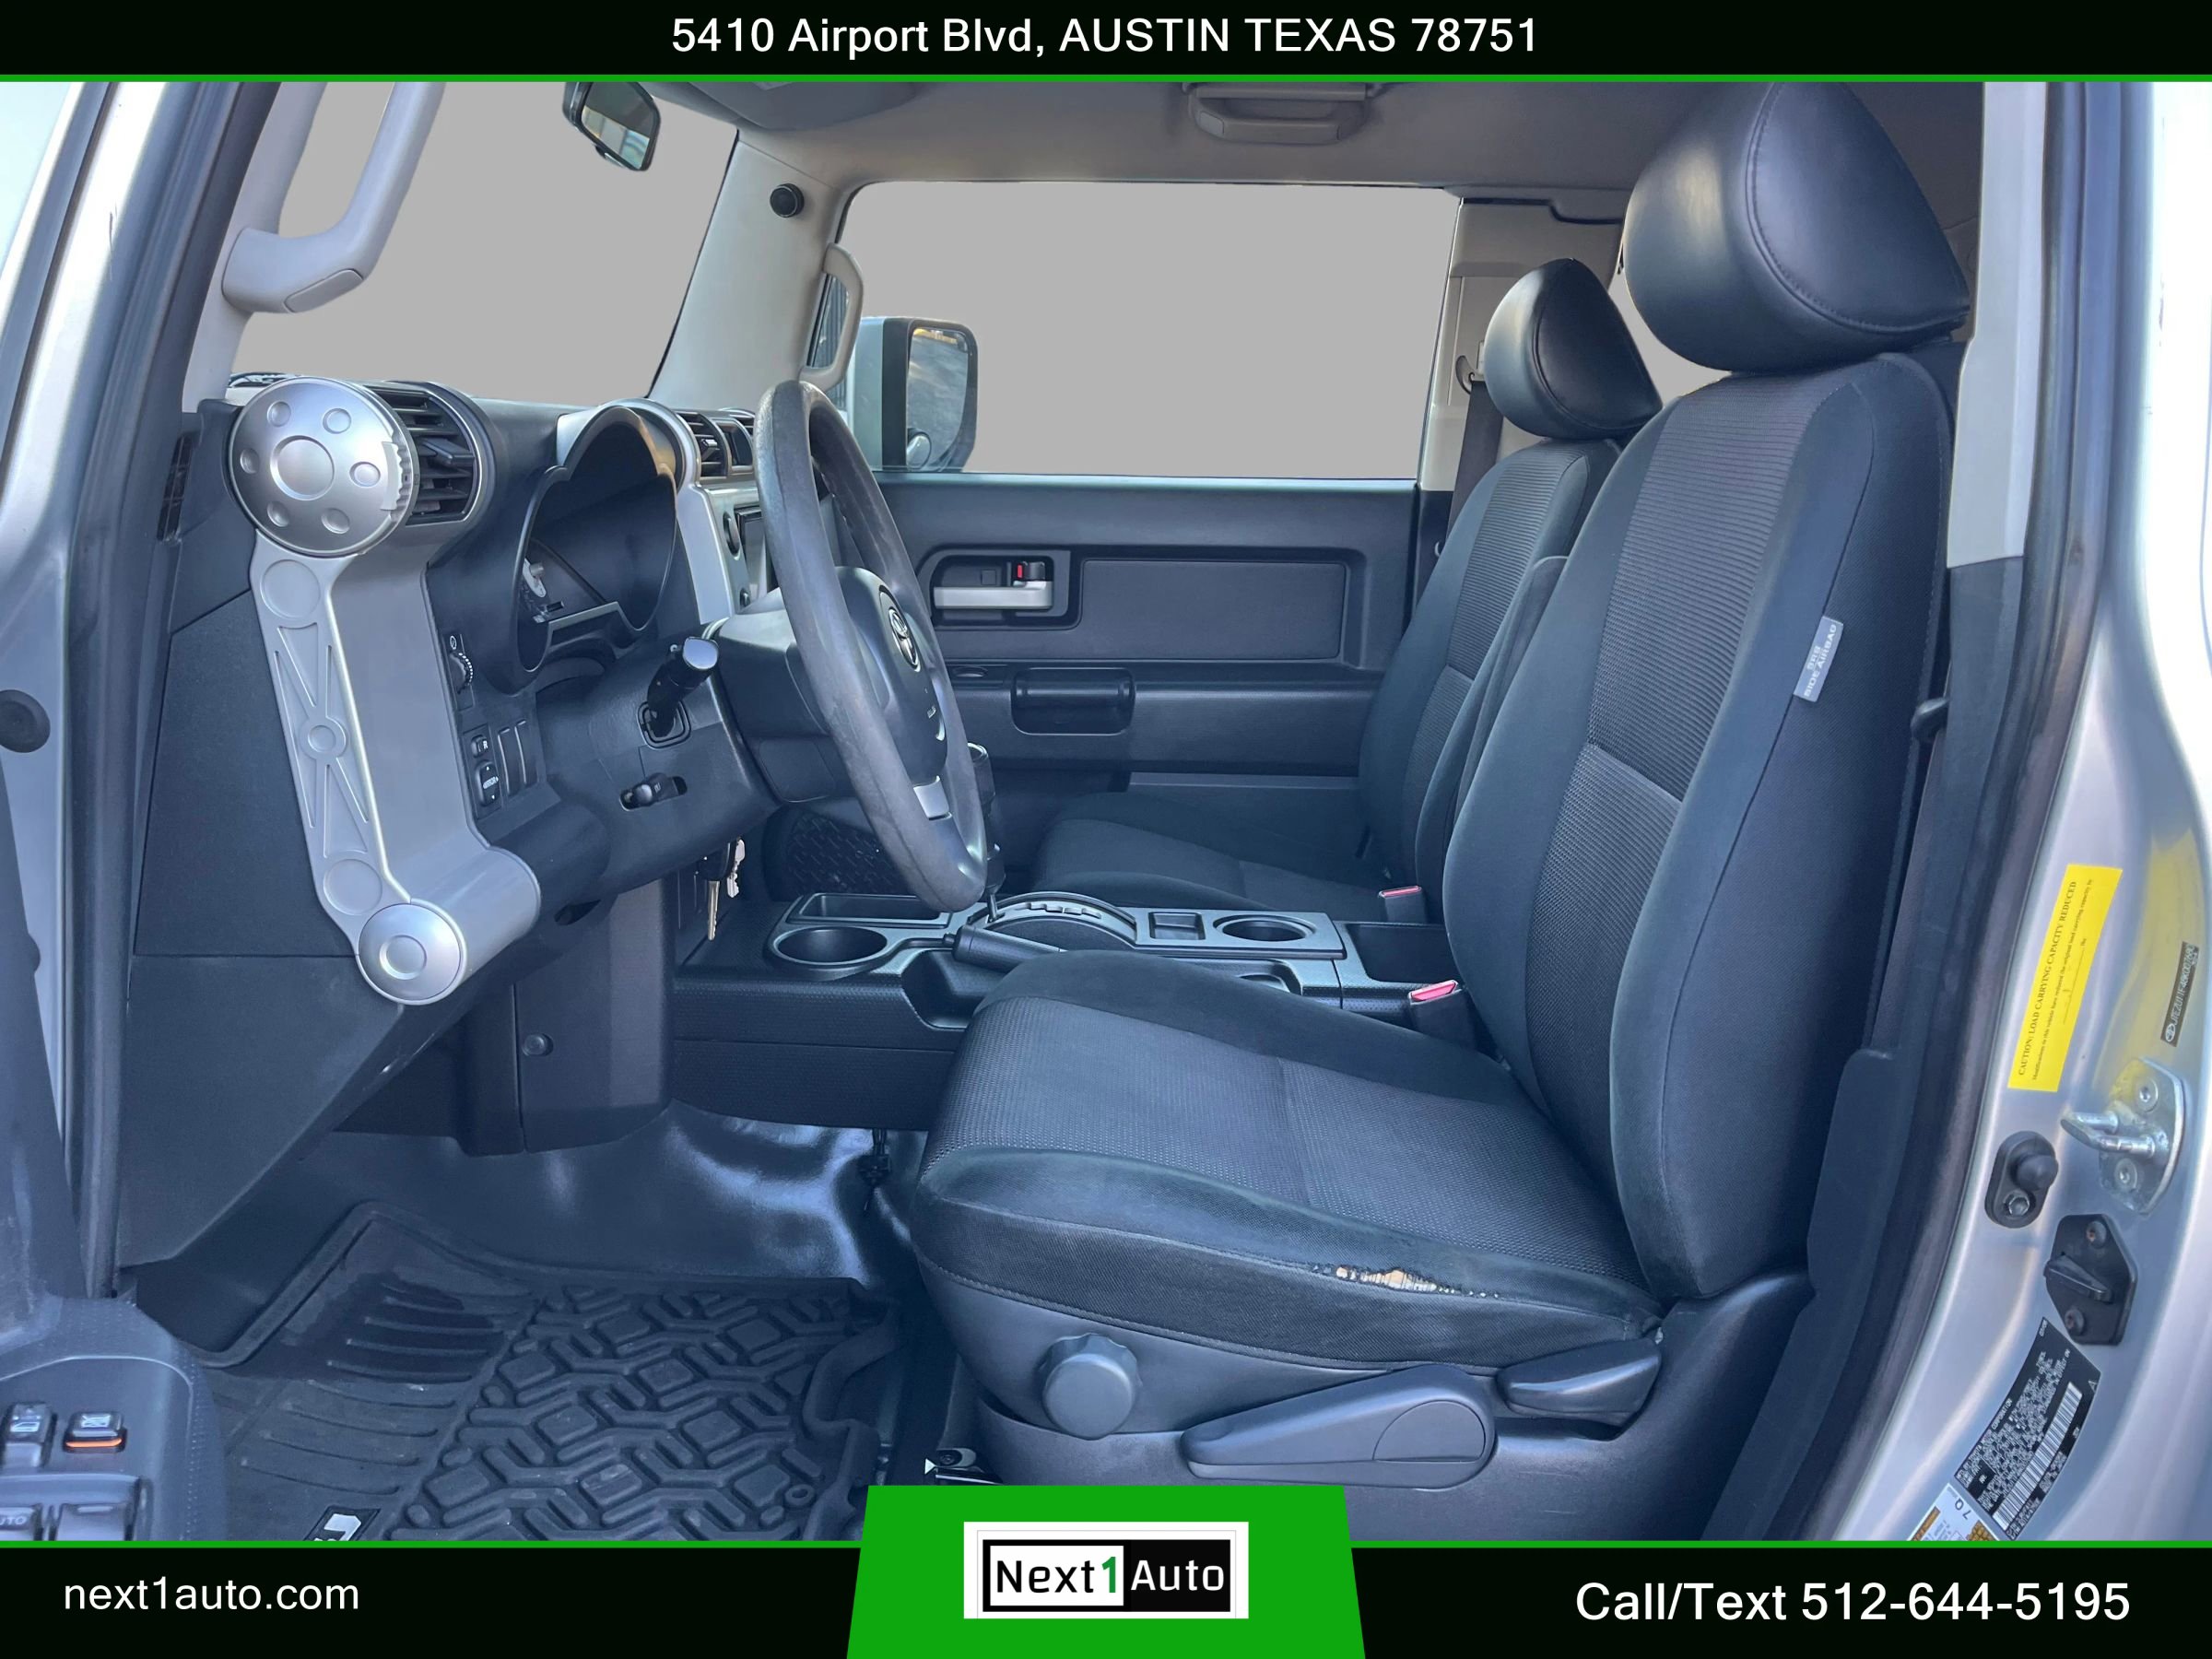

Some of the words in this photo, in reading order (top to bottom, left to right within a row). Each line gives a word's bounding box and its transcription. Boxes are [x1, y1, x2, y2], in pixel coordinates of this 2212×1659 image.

[2059, 880, 2077, 922] REDUCED
[2046, 924, 2064, 965] CAPACITY
[2034, 966, 2053, 1010] CARRYING
[2028, 1011, 2041, 1035] LOAD
[0, 1515, 26, 1526] UTO
